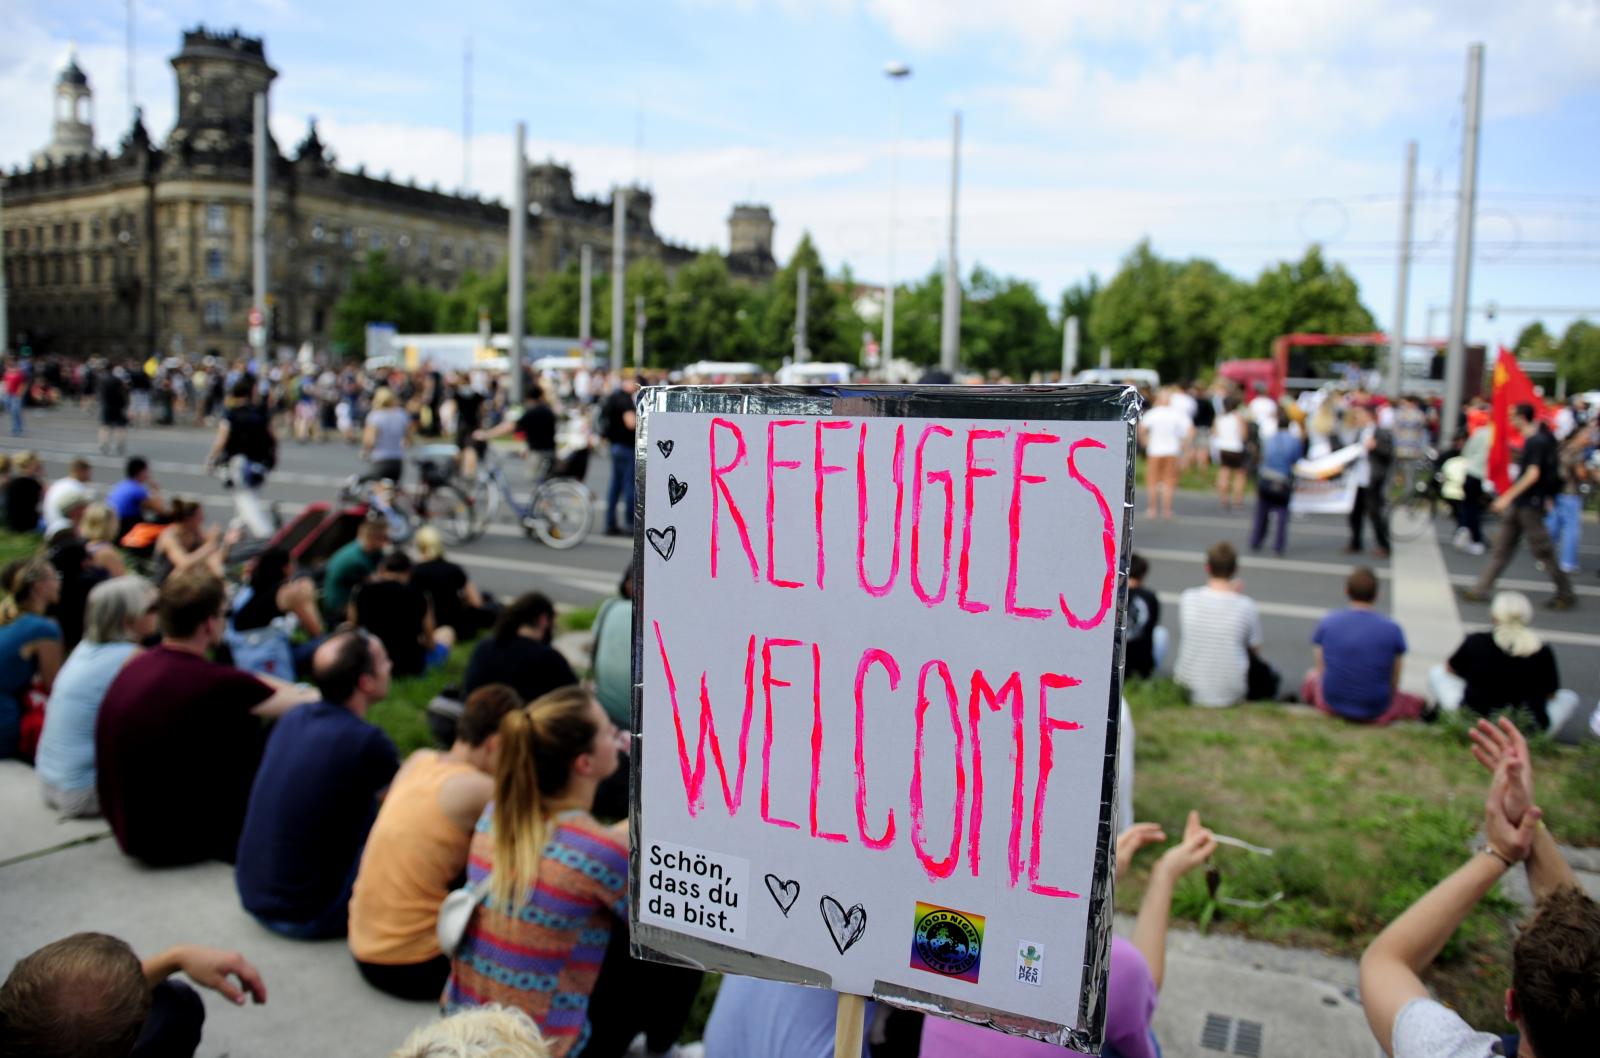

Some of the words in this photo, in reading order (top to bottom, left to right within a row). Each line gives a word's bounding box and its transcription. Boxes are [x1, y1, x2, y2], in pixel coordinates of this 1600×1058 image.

[709, 417, 1117, 630] REFUGEES
[653, 620, 1084, 898] WELCOME
[649, 844, 732, 887] Schön,
[649, 869, 701, 900] dass
[708, 883, 739, 909] du
[648, 894, 676, 920] da
[683, 901, 735, 934] bist.
[920, 914, 948, 933] GOOD
[950, 915, 978, 944] NIGHT
[948, 953, 976, 972] PRIDE
[1018, 964, 1039, 976] NZS
[1018, 972, 1038, 984] PKN
